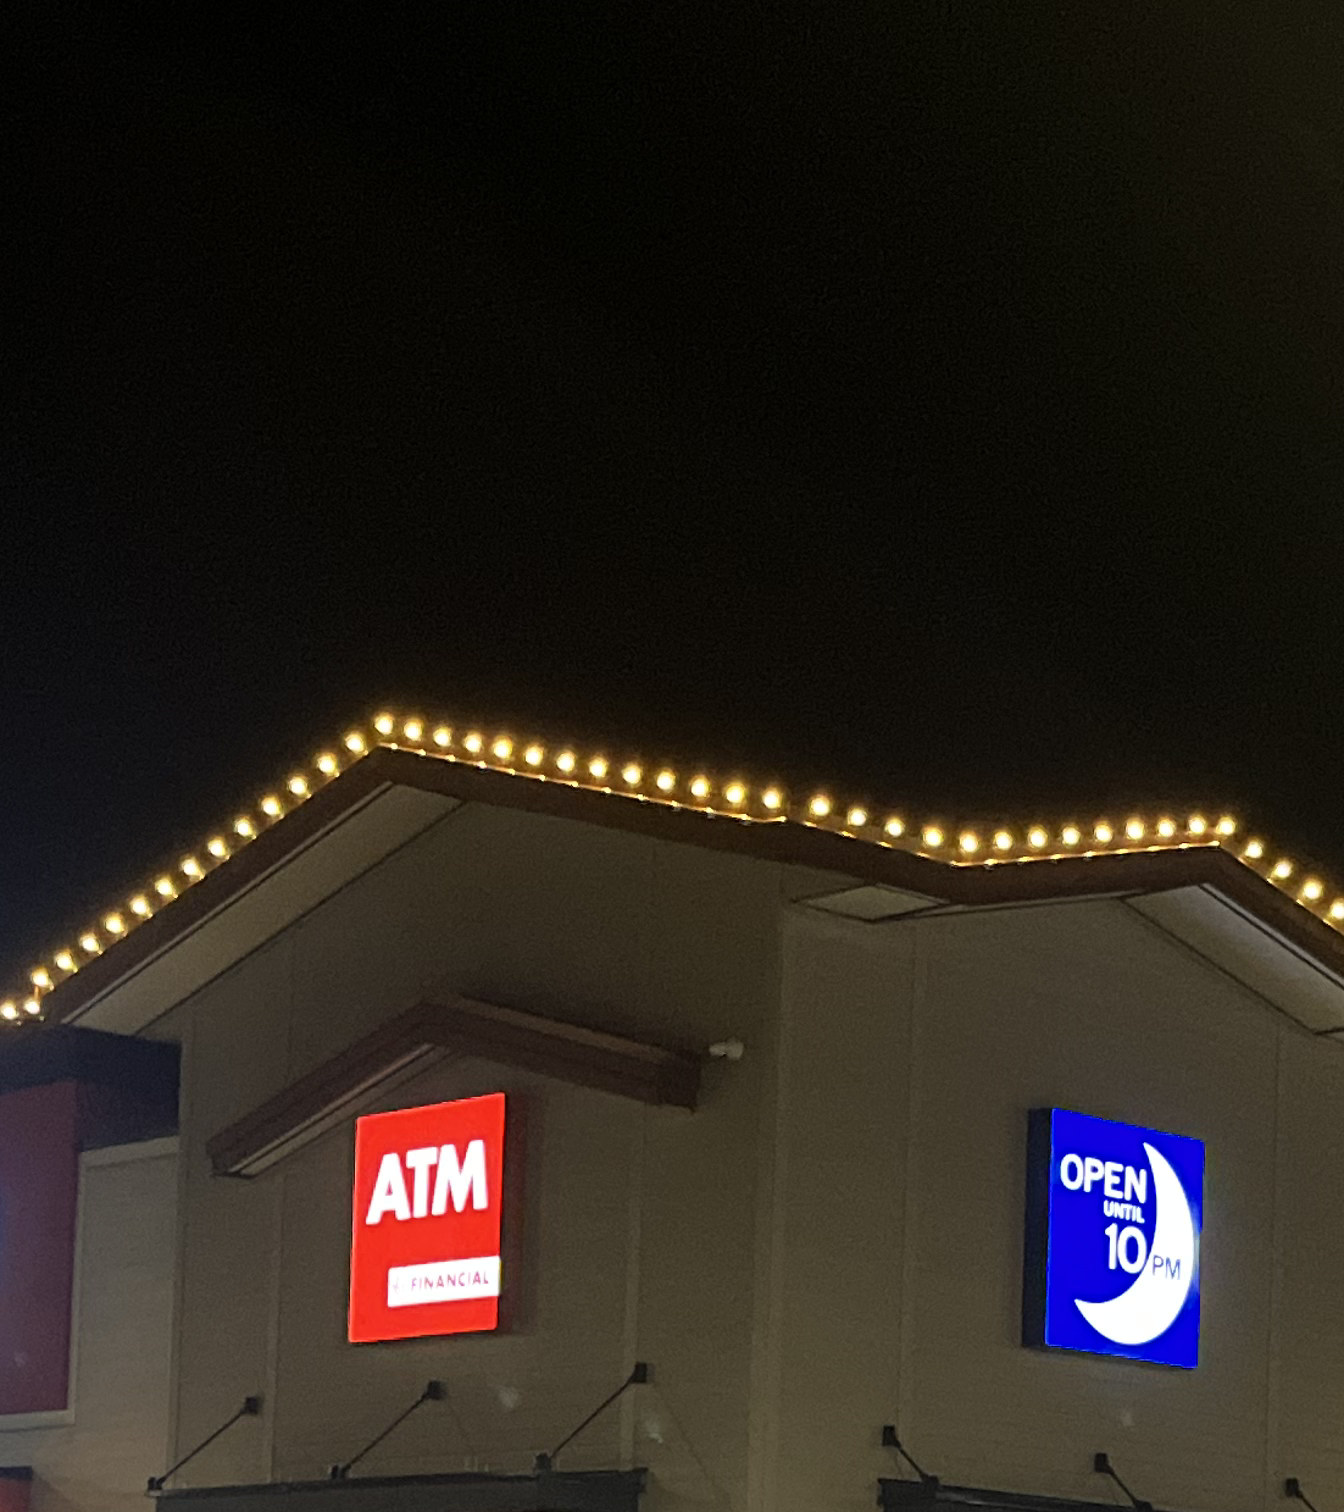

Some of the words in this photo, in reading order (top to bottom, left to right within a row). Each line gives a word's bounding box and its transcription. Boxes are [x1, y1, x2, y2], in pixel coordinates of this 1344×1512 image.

[365, 1139, 489, 1226] ATM
[1060, 1153, 1148, 1204] OPEN
[1103, 1199, 1146, 1224] UNTIL
[1104, 1222, 1148, 1275] 10
[1152, 1254, 1182, 1281] PM
[410, 1270, 490, 1290] FINANCIAL
